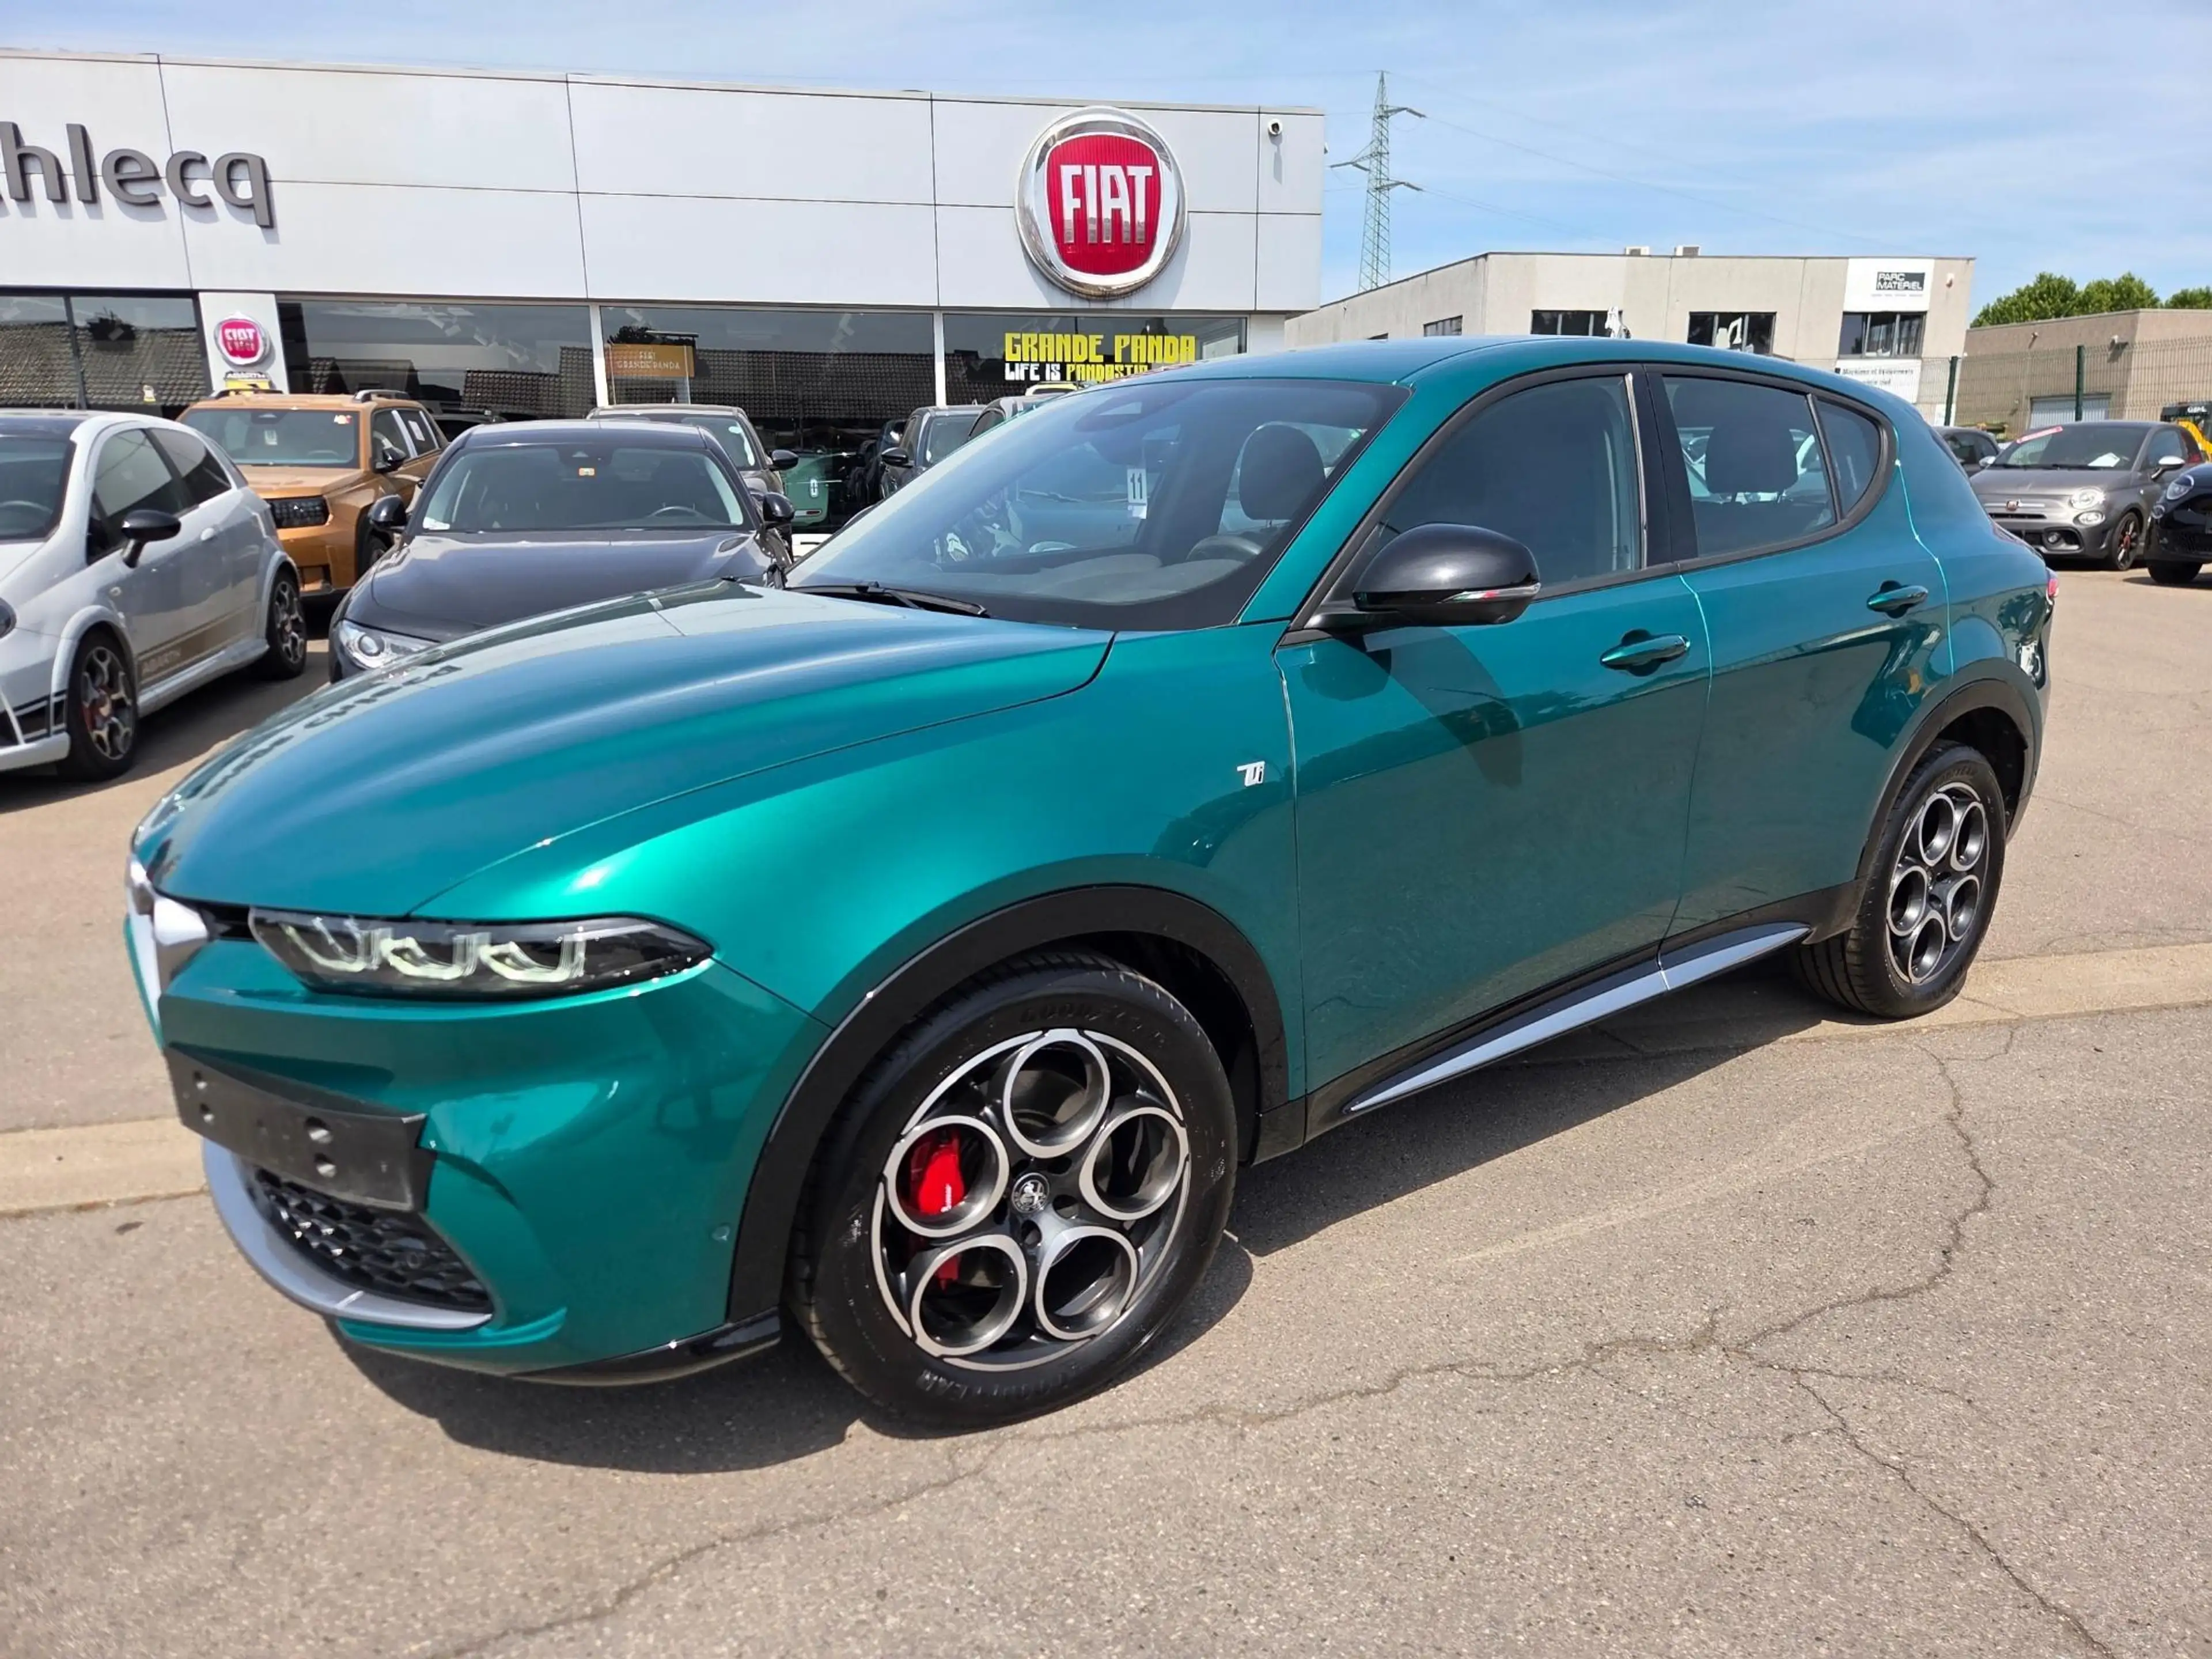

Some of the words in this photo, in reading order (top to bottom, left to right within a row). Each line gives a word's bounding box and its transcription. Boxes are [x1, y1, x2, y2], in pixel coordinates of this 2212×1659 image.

[0, 121, 274, 228] hlecq
[1060, 164, 1153, 244] FIAT
[1878, 273, 1906, 281] PARC
[225, 328, 256, 352] FIAT
[1005, 333, 1104, 362] GRANDE
[1115, 335, 1196, 364] PANDA
[653, 361, 680, 369] PANDA
[1005, 363, 1040, 381] LIFE
[1046, 363, 1061, 381] IS
[1130, 472, 1143, 500] 11
